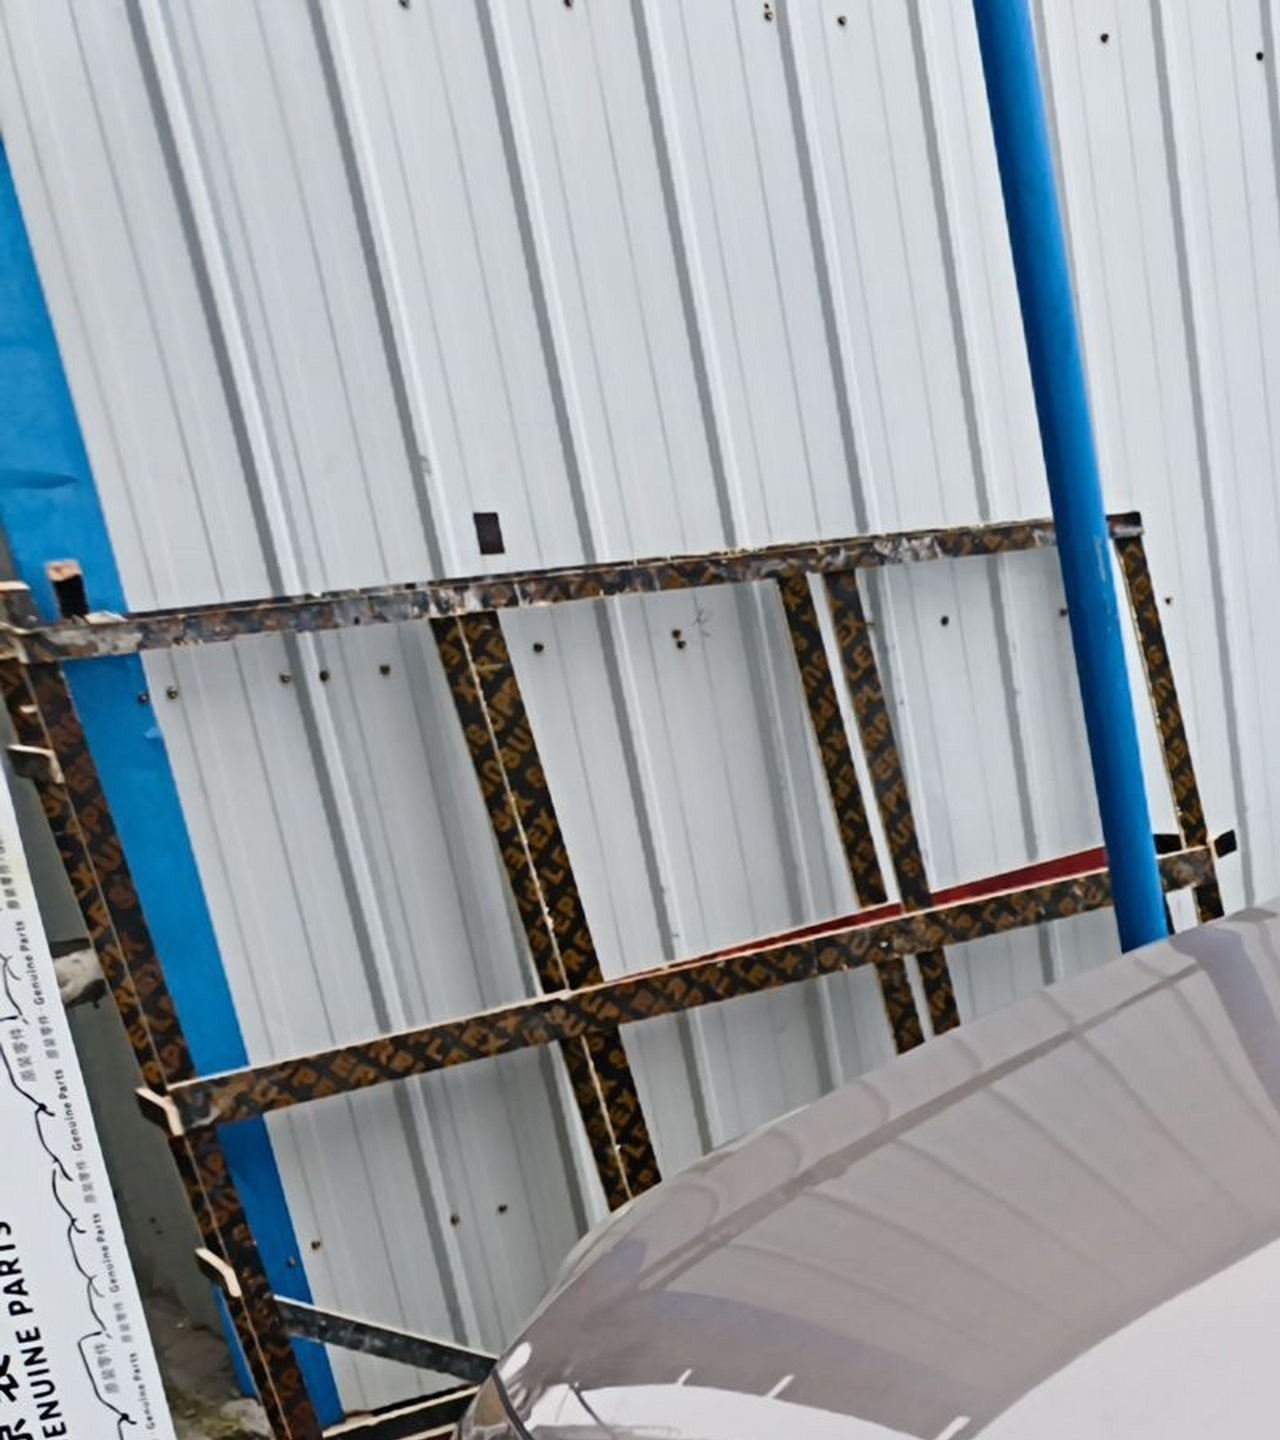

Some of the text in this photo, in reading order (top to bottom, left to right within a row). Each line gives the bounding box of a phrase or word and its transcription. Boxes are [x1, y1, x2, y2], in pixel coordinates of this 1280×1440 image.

[15, 920, 29, 952] Parts
[25, 953, 45, 1005] Genuine
[54, 1069, 67, 1100] Parts
[63, 1102, 83, 1151] Genuine
[92, 1213, 105, 1243] Parts
[101, 1245, 120, 1293] Genuine
[129, 1352, 142, 1382] Parts
[138, 1383, 156, 1430] Genuine
